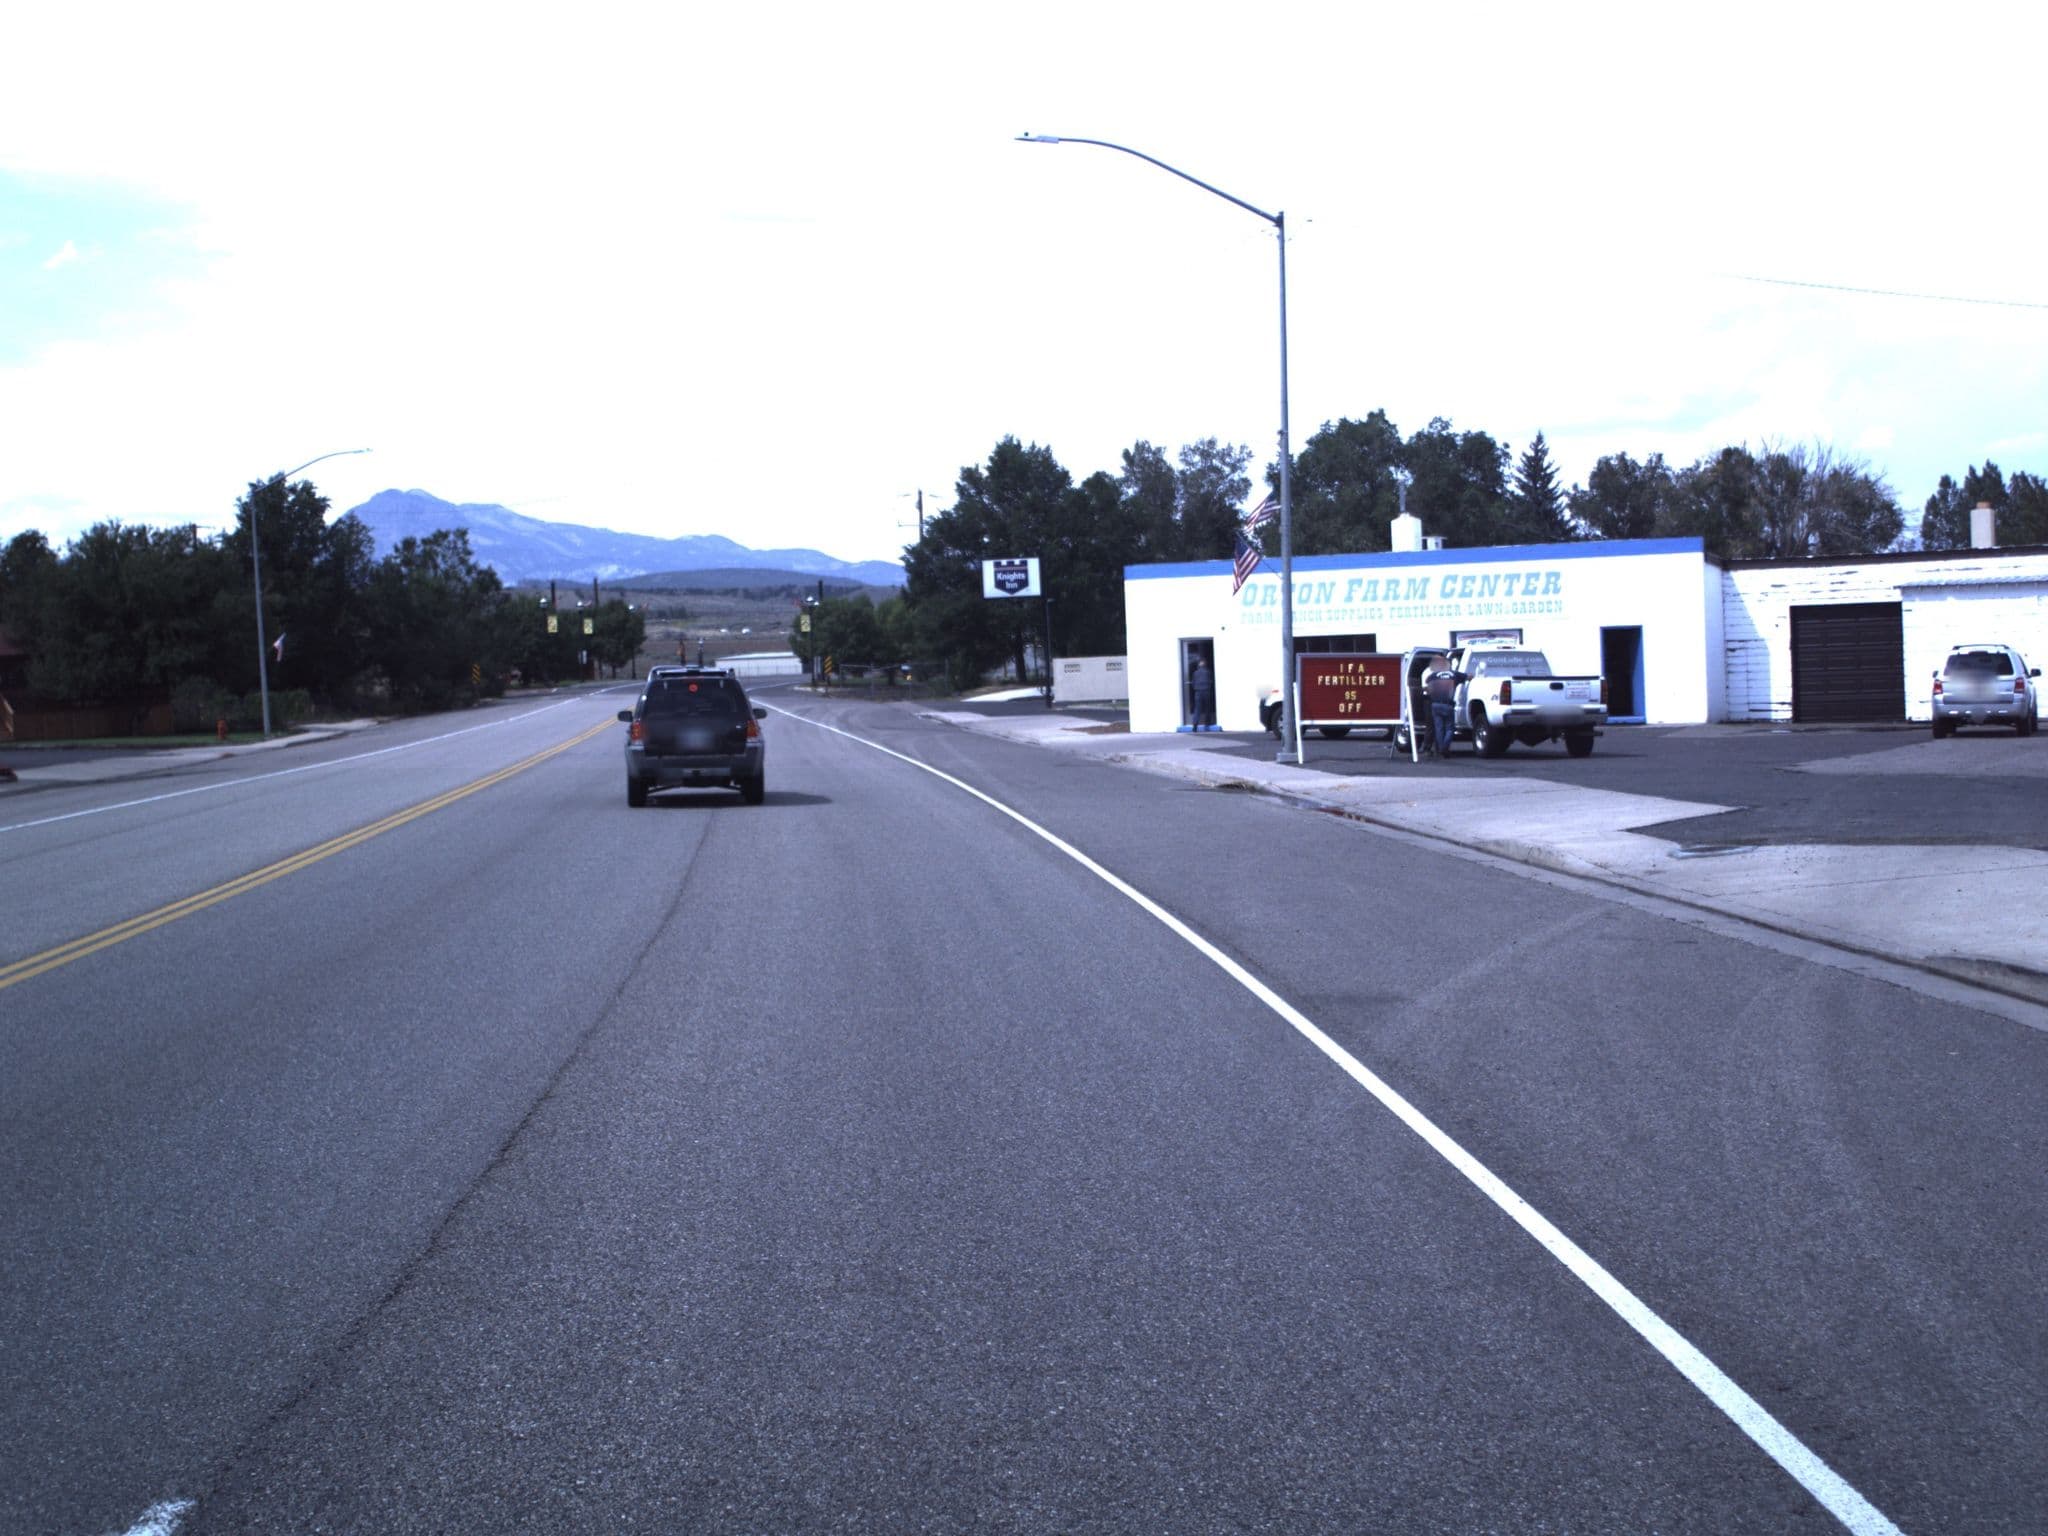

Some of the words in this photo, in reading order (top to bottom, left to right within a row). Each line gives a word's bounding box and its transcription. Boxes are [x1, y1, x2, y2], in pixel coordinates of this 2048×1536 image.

[997, 572, 1025, 581] Knights
[1005, 581, 1018, 589] Inn
[1241, 582, 1336, 607] ORON
[1343, 577, 1430, 604] FARM
[1439, 571, 1562, 599] CENTER
[1390, 603, 1461, 618] FERTILIZER
[1468, 602, 1502, 616] LAWN
[1511, 600, 1563, 615] GARDEN
[1317, 675, 1385, 686] FERTILIZER
[1338, 703, 1362, 713] OFF
